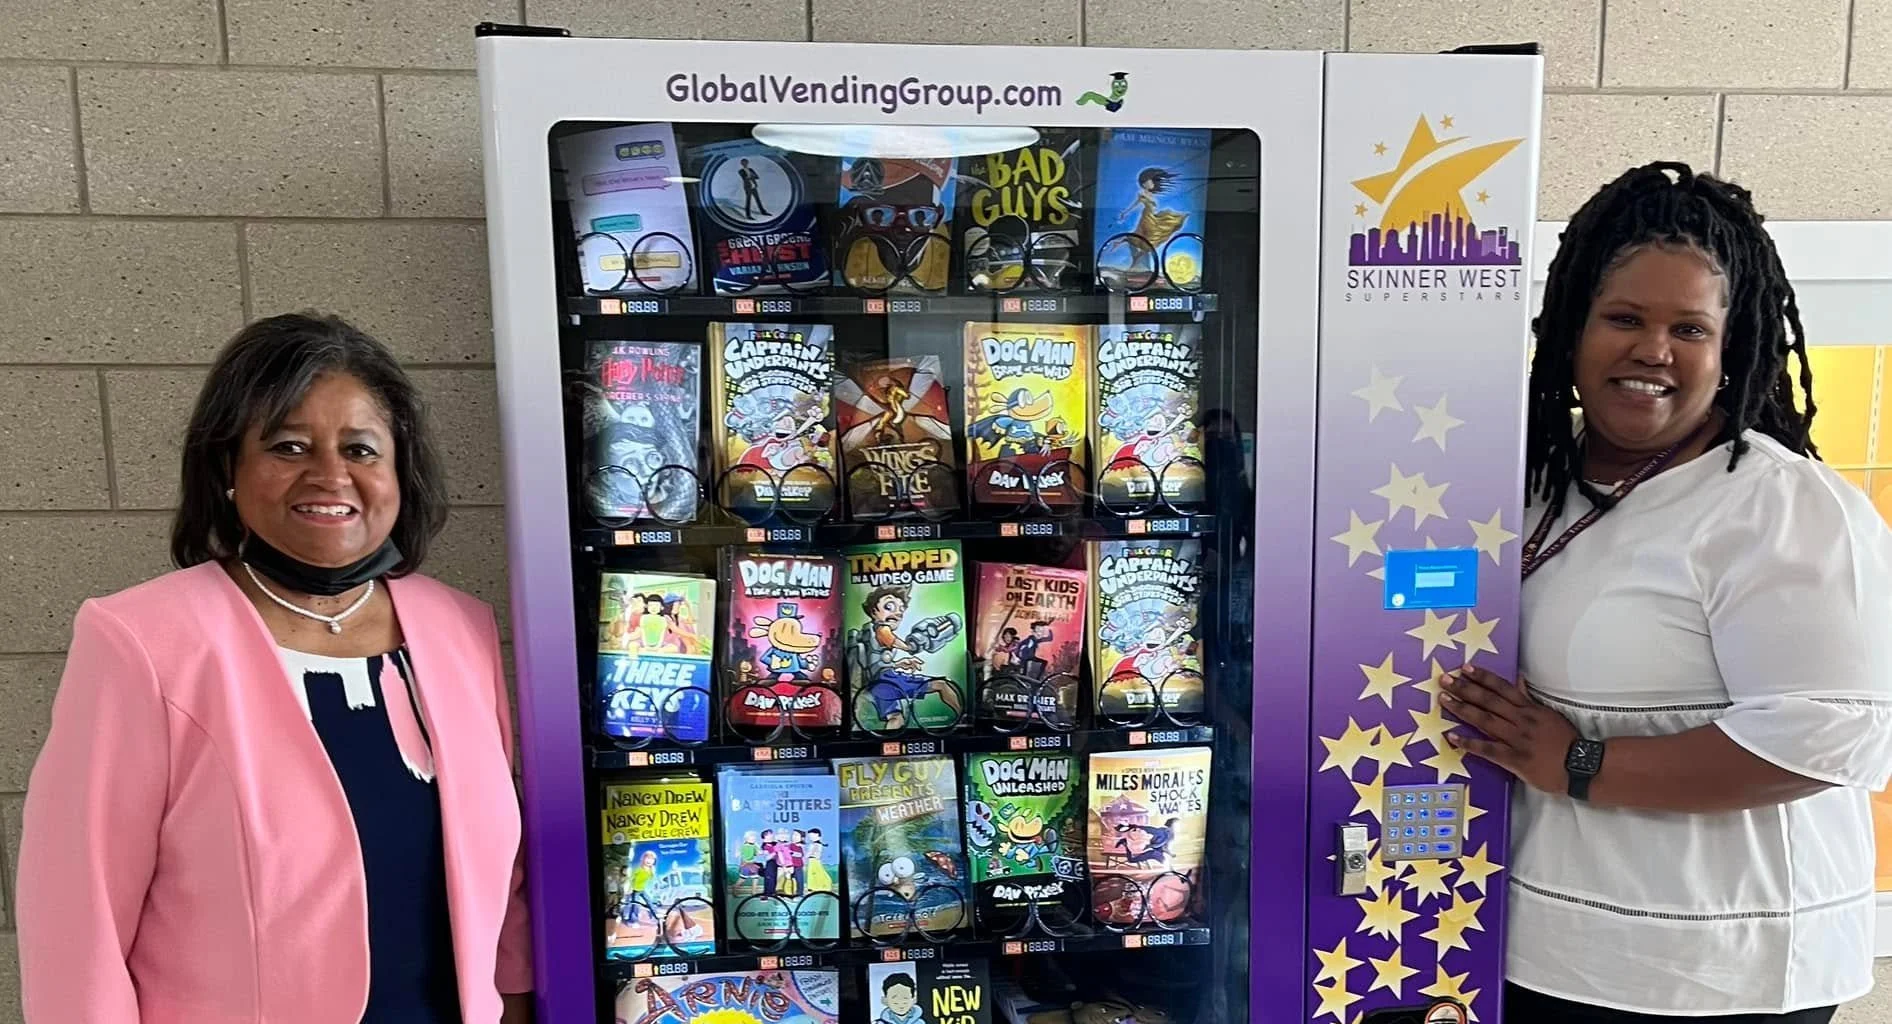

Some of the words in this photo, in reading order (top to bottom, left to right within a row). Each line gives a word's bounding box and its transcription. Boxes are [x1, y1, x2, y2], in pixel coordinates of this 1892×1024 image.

[665, 73, 1063, 114] GlobalVendingGroup.com
[986, 148, 1065, 189] BAD
[971, 181, 1070, 227] GUYS
[1346, 269, 1447, 289] SKINNER
[1458, 268, 1521, 288] WEST
[1345, 292, 1521, 302] SUPERSTARS
[982, 337, 1028, 366] DOG
[1030, 337, 1076, 366] MAN
[724, 354, 831, 379] UNDERPANTS
[1097, 354, 1199, 380] UNDERPANTS
[859, 446, 938, 473] WINGS
[988, 470, 1020, 489] DAV
[738, 559, 785, 587] DOG
[788, 560, 834, 588] MAN
[846, 548, 959, 574] TRAPPED
[870, 571, 912, 586] VIDEO
[915, 569, 954, 583] GAME
[1005, 576, 1041, 591] LAST
[1044, 578, 1080, 594] KIDS
[1098, 570, 1198, 594] UNDERPANTS
[1006, 591, 1023, 602] ON
[1023, 591, 1078, 611] EARTH
[612, 658, 697, 687] THREE
[610, 686, 685, 713] KEYS
[744, 690, 776, 710] DAV
[838, 761, 889, 788] FLY
[893, 757, 948, 783] GUY
[981, 758, 1026, 786] DOG
[1027, 757, 1070, 782] MAN
[1096, 773, 1139, 791] MILES
[664, 788, 707, 805] DREW
[849, 783, 935, 801] PRESENTS
[1150, 787, 1198, 803] SHOCK
[659, 807, 702, 828] DREW
[878, 796, 945, 821] WEATHER
[992, 884, 1022, 901] DAV
[931, 984, 982, 1018] NEW
